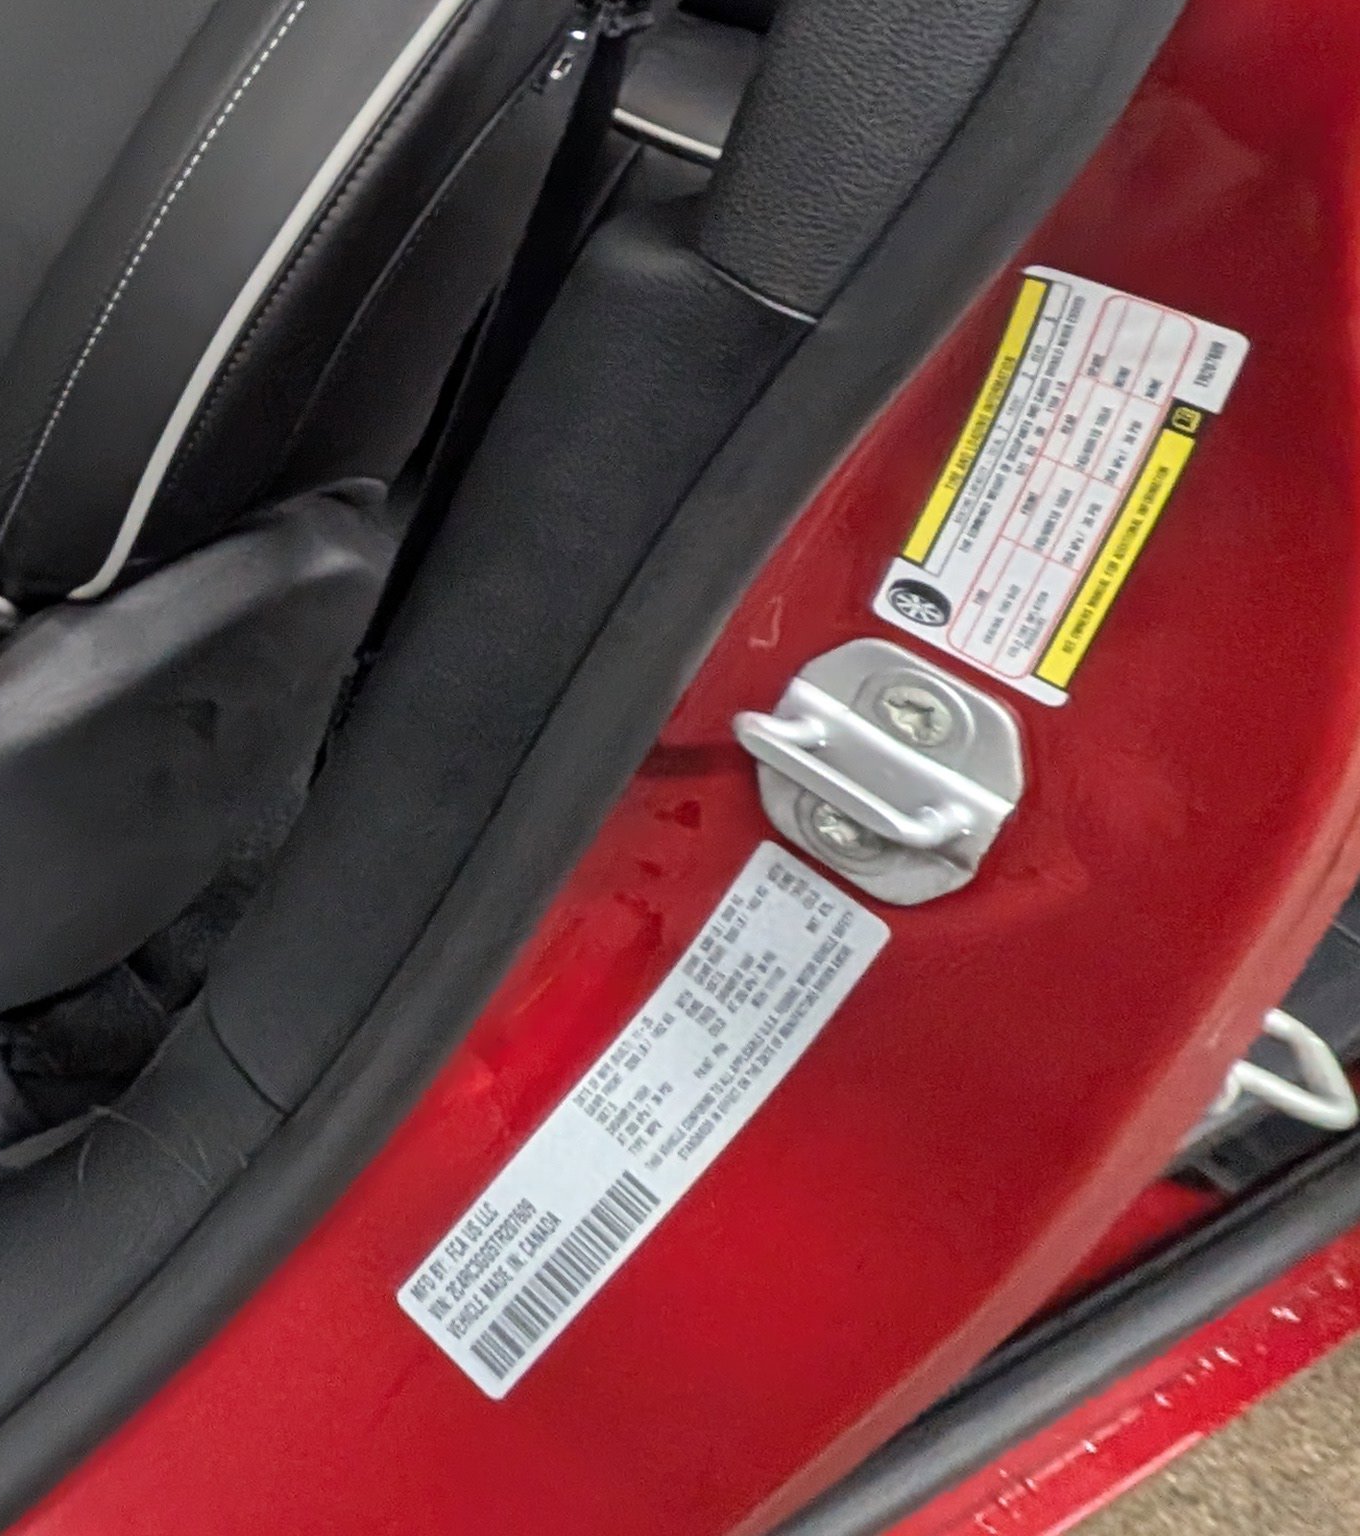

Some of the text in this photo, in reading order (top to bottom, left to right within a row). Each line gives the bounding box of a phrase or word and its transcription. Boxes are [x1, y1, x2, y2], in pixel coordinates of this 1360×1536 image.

[471, 1199, 500, 1229] LLC
[445, 1292, 489, 1342] VEHICLE
[478, 1263, 515, 1303] MADE
[516, 1207, 562, 1259] CANADA
